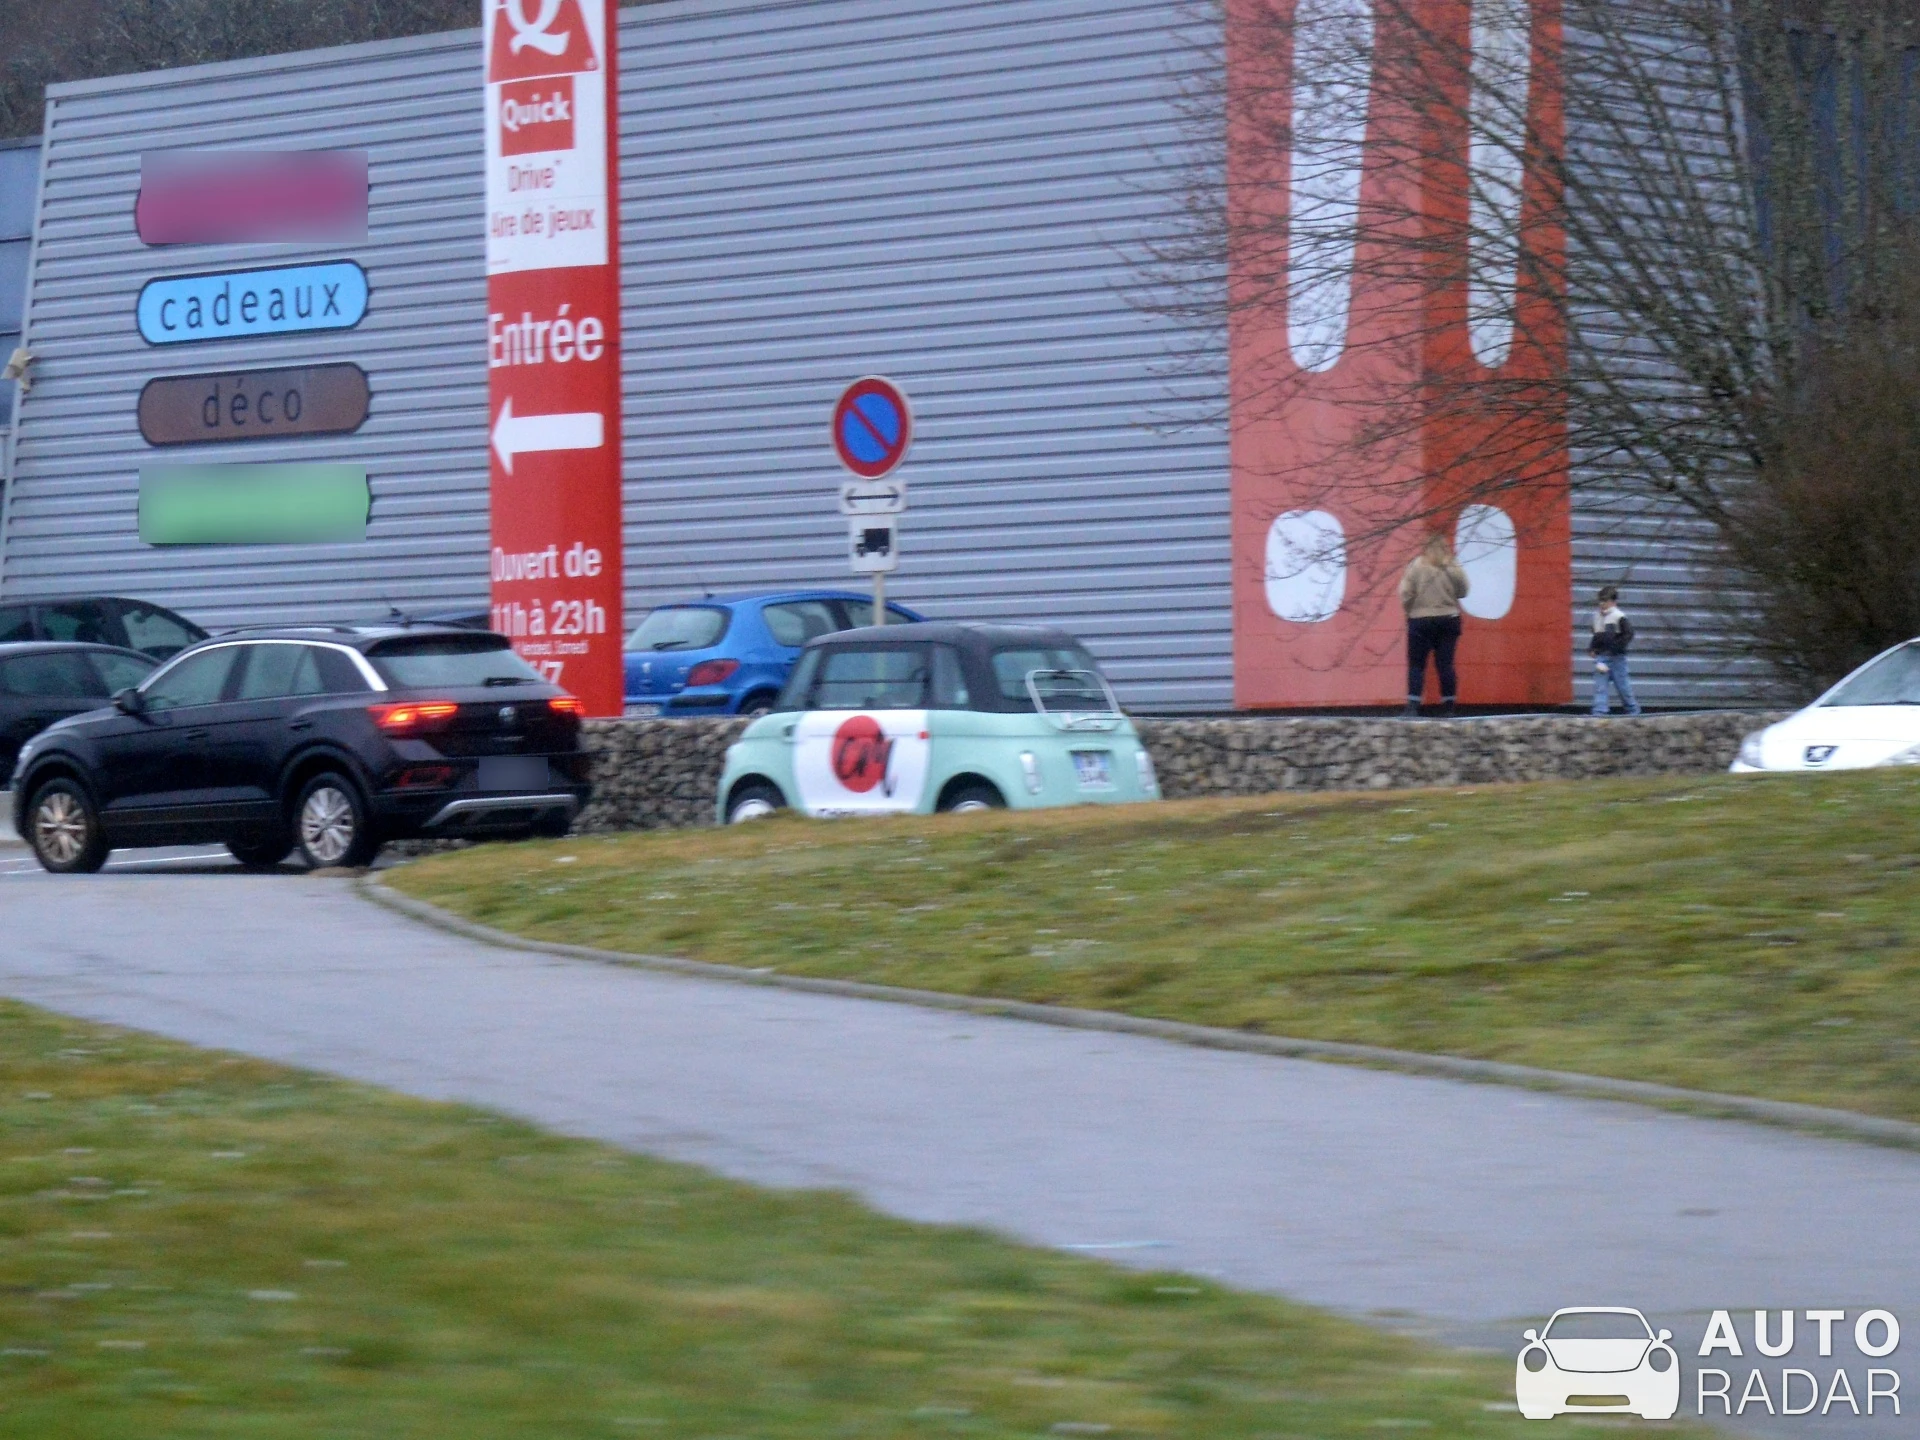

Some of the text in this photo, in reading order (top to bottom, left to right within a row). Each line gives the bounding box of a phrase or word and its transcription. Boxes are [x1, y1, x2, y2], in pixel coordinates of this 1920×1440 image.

[501, 92, 571, 132] Quick
[521, 208, 544, 235] de
[547, 205, 596, 238] jeux
[160, 281, 342, 331] cadeaux
[488, 303, 604, 368] Entrée
[203, 378, 302, 428] déco
[491, 542, 602, 583] Ouvert de
[492, 599, 606, 637] 11h à 23h
